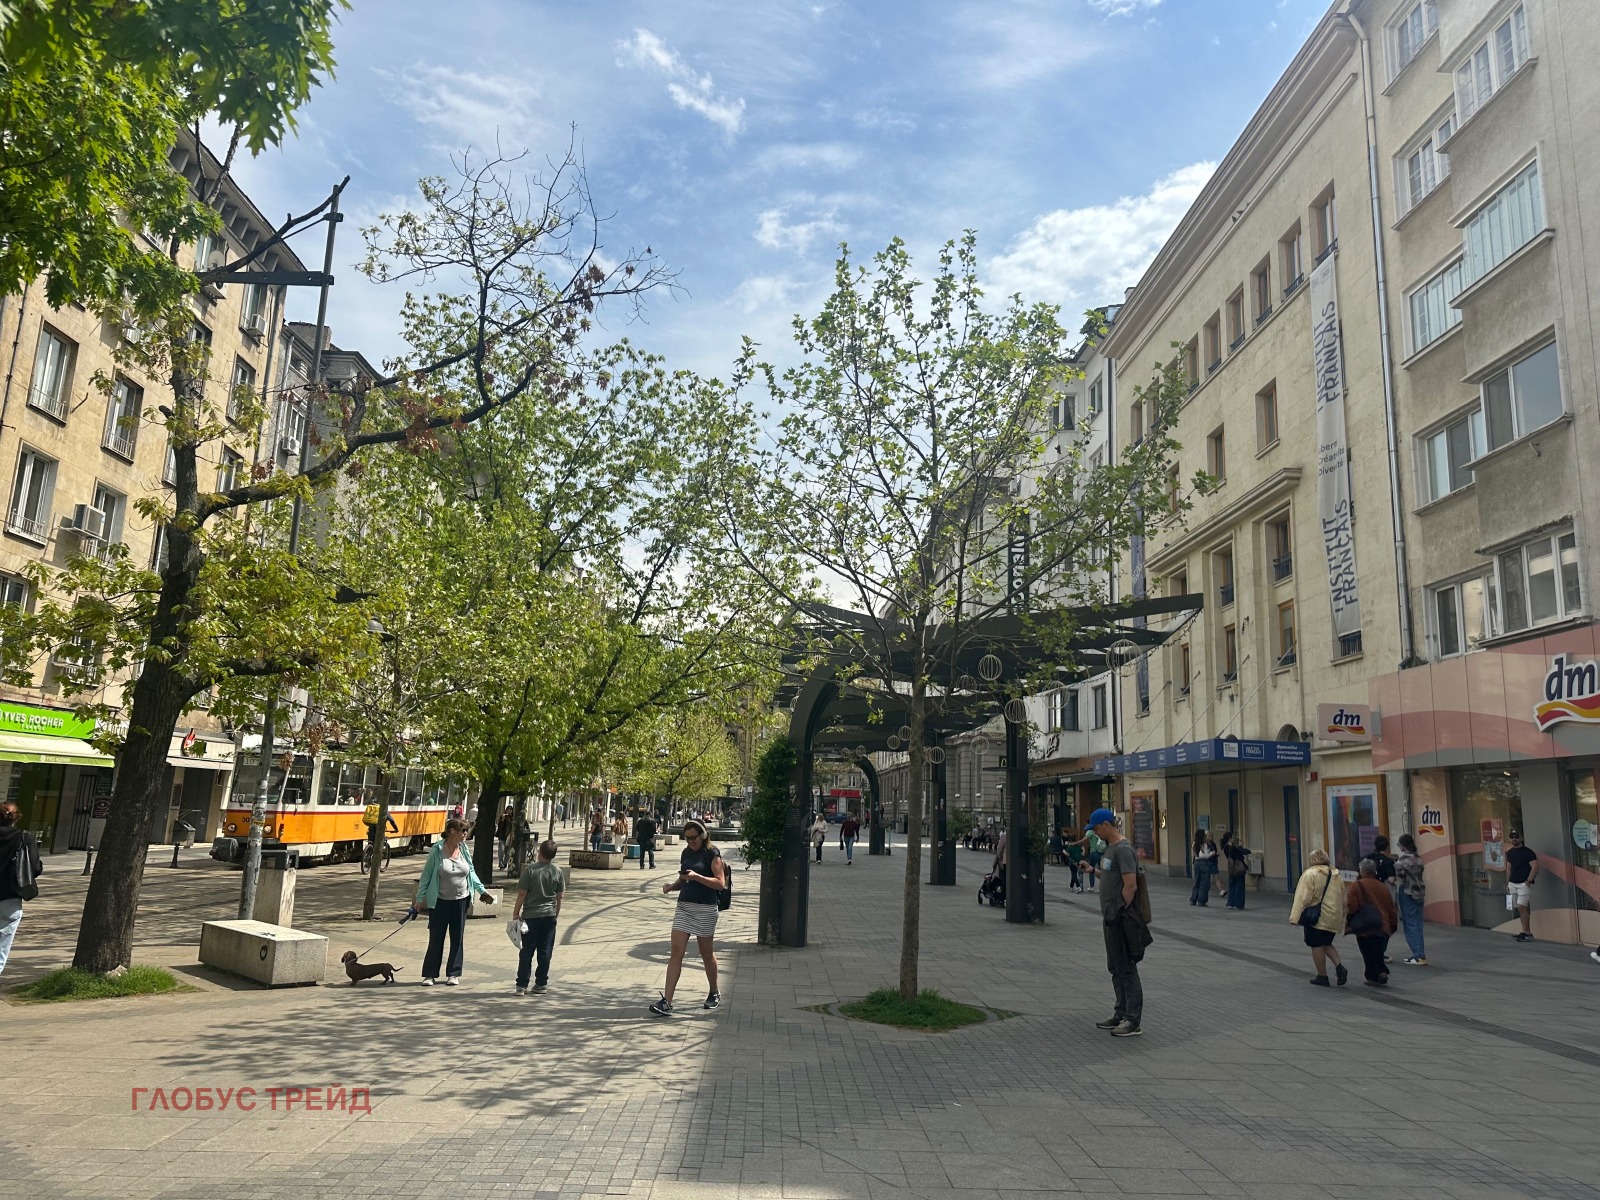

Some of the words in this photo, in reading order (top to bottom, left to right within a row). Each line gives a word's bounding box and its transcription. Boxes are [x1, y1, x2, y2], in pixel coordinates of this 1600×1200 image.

[1313, 321, 1327, 413] INSTITUT
[1321, 301, 1341, 404] FRANÇAIS
[1322, 515, 1346, 614] INSTITUT
[1335, 499, 1358, 606] FRANÇAIS
[1545, 657, 1595, 701] dm
[3, 711, 27, 723] YVES
[28, 714, 64, 728] ROCHER
[1333, 709, 1361, 726] dm
[1421, 805, 1441, 825] dm
